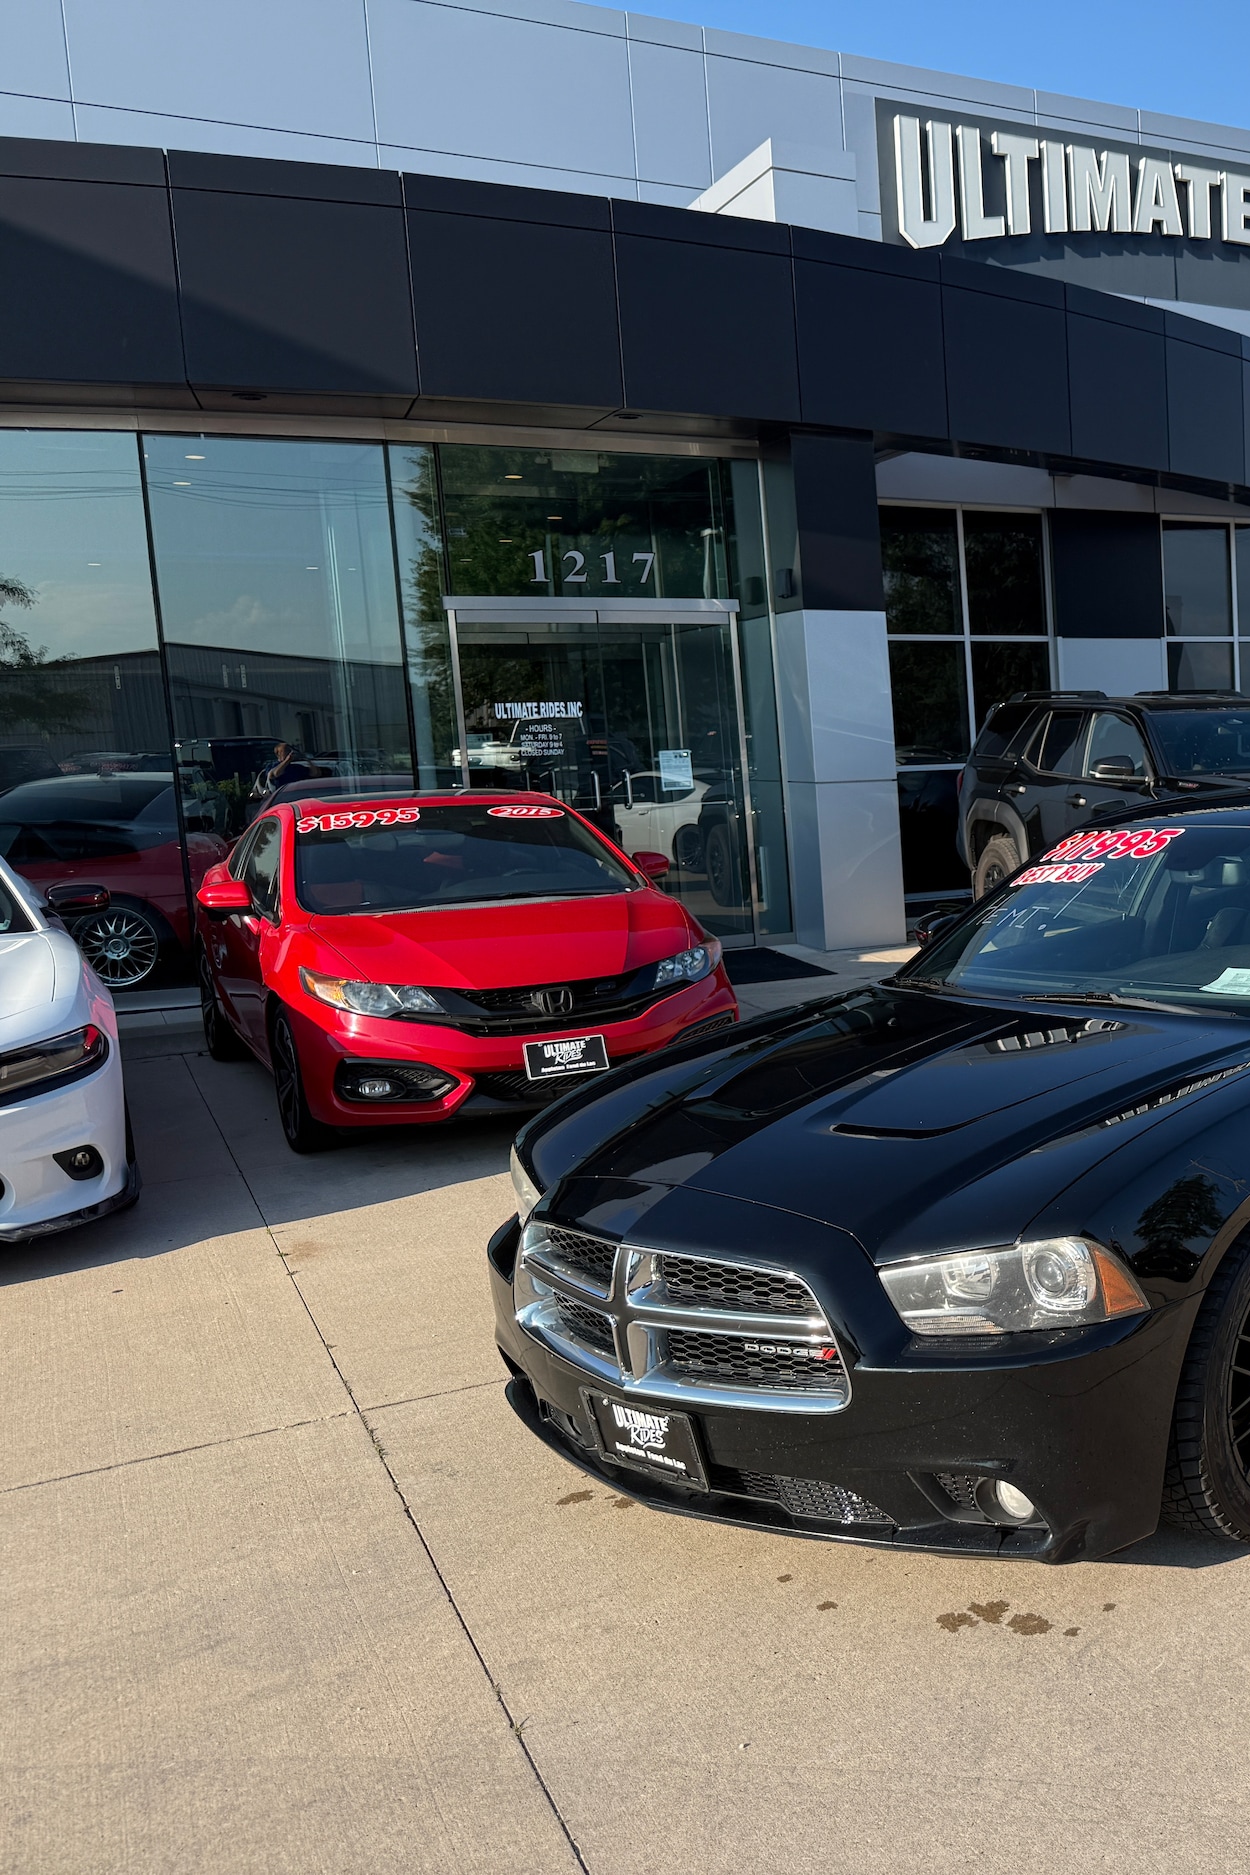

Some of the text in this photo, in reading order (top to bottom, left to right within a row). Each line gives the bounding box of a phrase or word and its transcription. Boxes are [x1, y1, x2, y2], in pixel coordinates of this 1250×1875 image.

[528, 549, 655, 584] 1217
[494, 702, 538, 719] ULTIMATE
[528, 724, 553, 733] HOURS
[521, 748, 565, 757] CLOSED SUNDAY
[296, 807, 421, 833] $15995
[499, 806, 552, 816] 2015
[1039, 828, 1186, 862] $11995
[1009, 862, 1105, 887] BEST BUY
[543, 1040, 587, 1058] ULTIMATE
[744, 1343, 824, 1358] DODGE
[612, 1403, 670, 1432] ULTIMATE
